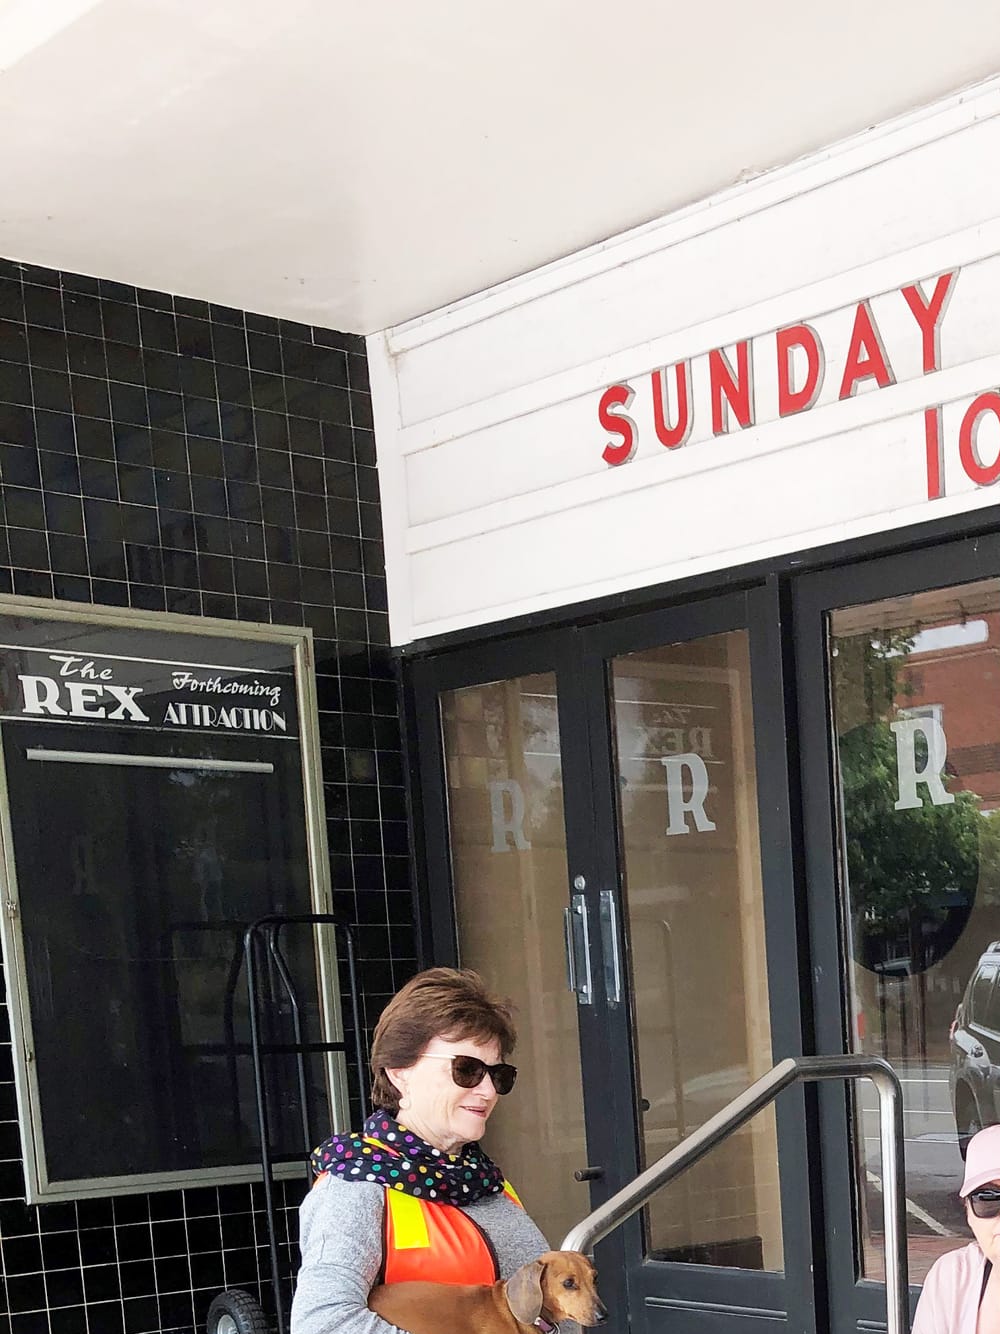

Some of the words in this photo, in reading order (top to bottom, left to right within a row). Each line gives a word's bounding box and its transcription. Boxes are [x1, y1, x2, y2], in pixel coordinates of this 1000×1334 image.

[598, 266, 961, 468] SUNDAY
[18, 674, 150, 722] REX
[49, 655, 113, 681] The
[171, 671, 282, 706] Forthcoming
[162, 702, 287, 732] ATTRACTION
[660, 752, 716, 836] R
[889, 717, 955, 811] R
[488, 778, 532, 852] R
